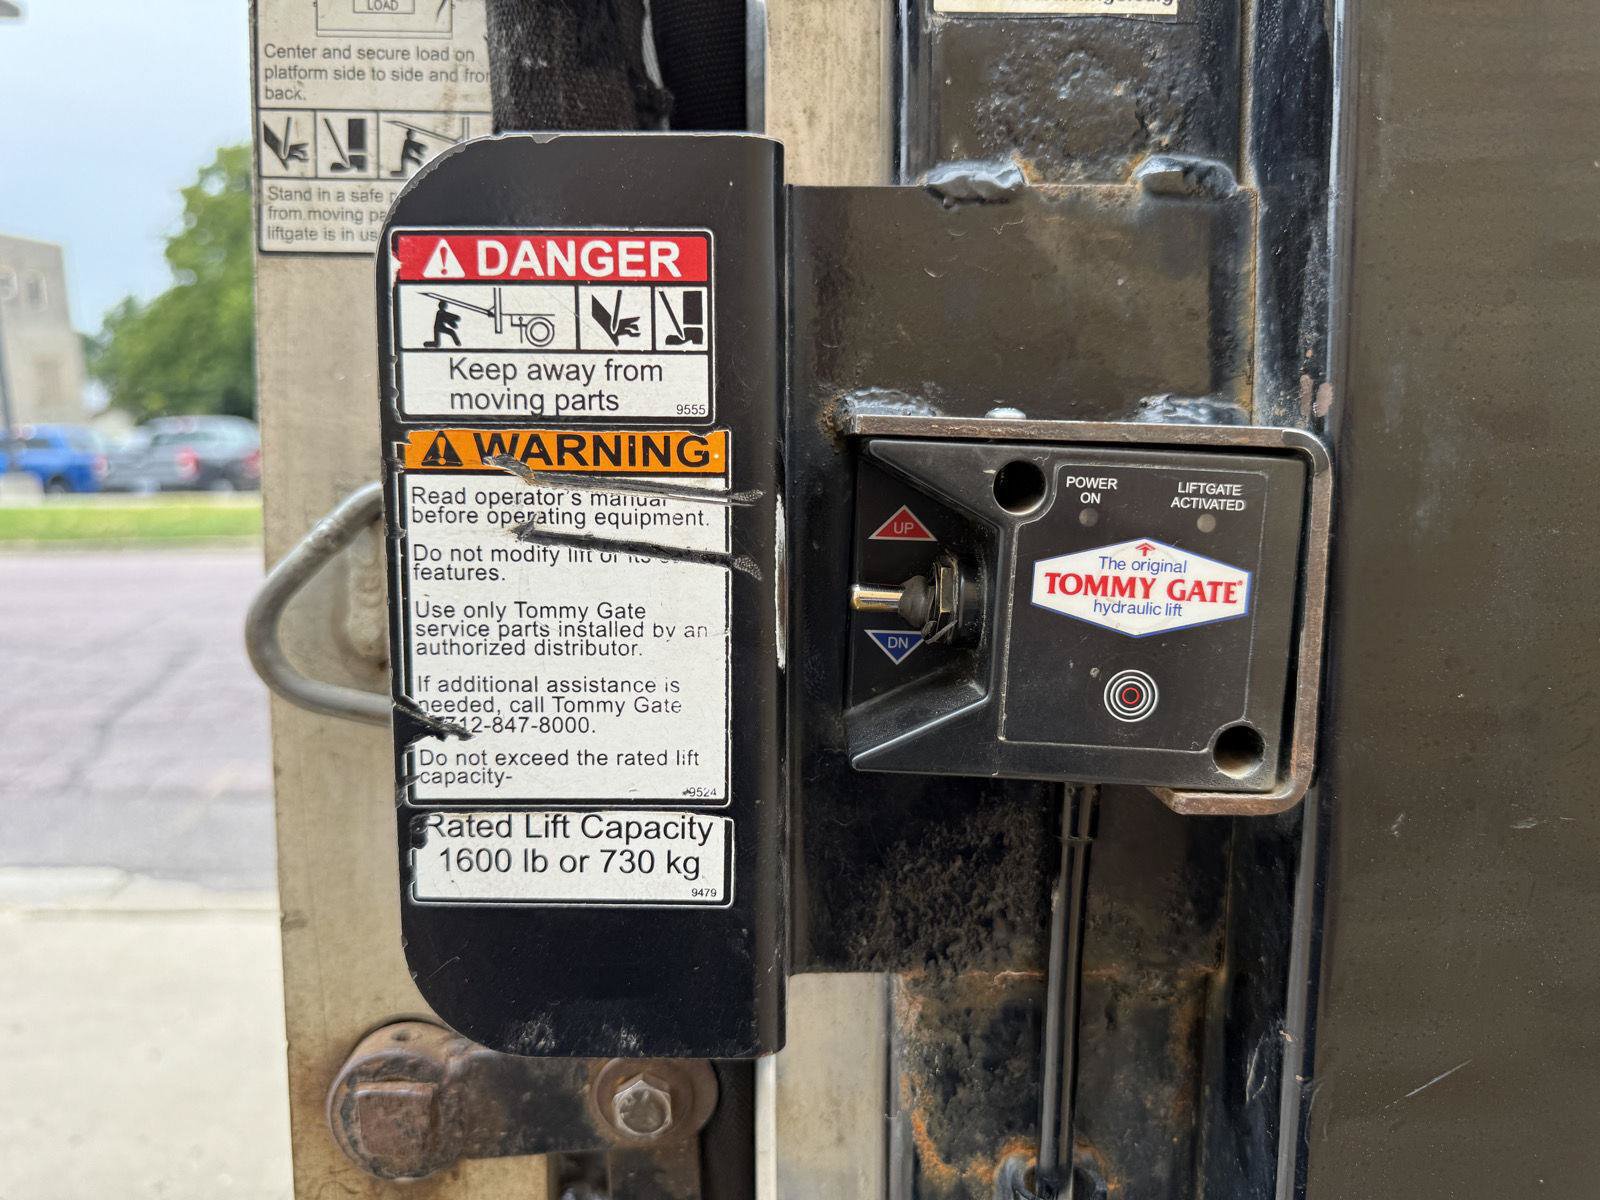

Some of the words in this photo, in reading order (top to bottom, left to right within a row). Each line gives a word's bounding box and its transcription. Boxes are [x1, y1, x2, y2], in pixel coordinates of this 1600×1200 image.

[368, 0, 399, 11] LOAD
[264, 44, 316, 58] Center
[322, 45, 351, 59] and
[357, 49, 410, 60] secure
[416, 46, 449, 61] load
[455, 50, 475, 61] on
[264, 66, 328, 80] platform
[334, 66, 366, 81] side
[371, 69, 386, 81] to
[391, 70, 423, 82] side
[430, 69, 458, 82] and
[265, 87, 306, 100] back.
[268, 187, 312, 201] Stand
[318, 187, 331, 200] in
[336, 190, 345, 201] a
[351, 190, 384, 201] safe
[268, 207, 306, 220] from
[308, 207, 363, 224] moving
[267, 226, 318, 241] liftgate
[324, 227, 336, 240] is
[342, 227, 355, 241] in
[360, 229, 378, 242] us
[476, 240, 681, 278] DANGER
[449, 357, 517, 386] Keep
[527, 363, 596, 385] away
[604, 359, 662, 381] from
[450, 388, 544, 415] moving
[555, 390, 620, 415] parts
[676, 404, 706, 415] 9555
[473, 431, 710, 467] WARNING
[1066, 477, 1118, 490] POWER
[1177, 482, 1242, 496] LIFTGATE
[412, 487, 465, 505] Read
[475, 489, 582, 510] operator's
[590, 492, 667, 507] manual
[1080, 492, 1101, 504] ON
[1170, 497, 1245, 511] ACTIVATED
[412, 507, 478, 523] before
[487, 510, 586, 529] operating
[595, 510, 710, 529] equipment.
[893, 522, 914, 534] UP
[414, 544, 442, 561] Do
[450, 547, 484, 561] not
[491, 547, 559, 566] modify
[413, 564, 506, 581] features.
[1098, 556, 1126, 570] The
[1131, 559, 1187, 574] original
[1044, 572, 1157, 599] TOMMY
[1166, 578, 1238, 604] GATE
[415, 602, 455, 618] Use
[463, 601, 506, 623] only
[514, 602, 589, 623] Tommy
[597, 603, 646, 619] Gate
[1093, 600, 1162, 616] hydraulic
[1165, 602, 1182, 617] lift
[415, 621, 490, 637] service
[499, 623, 550, 641] parts
[558, 621, 644, 638] installed
[653, 624, 676, 642] by
[684, 625, 708, 637] an
[416, 639, 526, 656] authorized
[534, 640, 643, 656] distributor.
[888, 637, 908, 649] DN
[418, 676, 432, 693] If
[438, 676, 538, 693] additional
[546, 678, 656, 693] assistance
[664, 677, 680, 693] is
[419, 697, 501, 717] needed,
[509, 697, 544, 713] call
[553, 697, 625, 717] Tommy
[634, 697, 682, 713] Gate
[419, 751, 447, 766] Do
[456, 752, 487, 766] not
[495, 750, 569, 766] exceed
[577, 751, 608, 766] the
[616, 750, 668, 766] rated
[676, 750, 700, 766] lift
[689, 787, 717, 798] 9524
[428, 814, 512, 838] Rated
[525, 814, 570, 838] Lift
[581, 815, 713, 846] Capacity
[439, 848, 513, 873] 1600
[523, 848, 548, 873] lb
[559, 855, 590, 873] or
[600, 850, 655, 874] 730
[667, 849, 701, 880] kg
[691, 887, 717, 898] 9479
